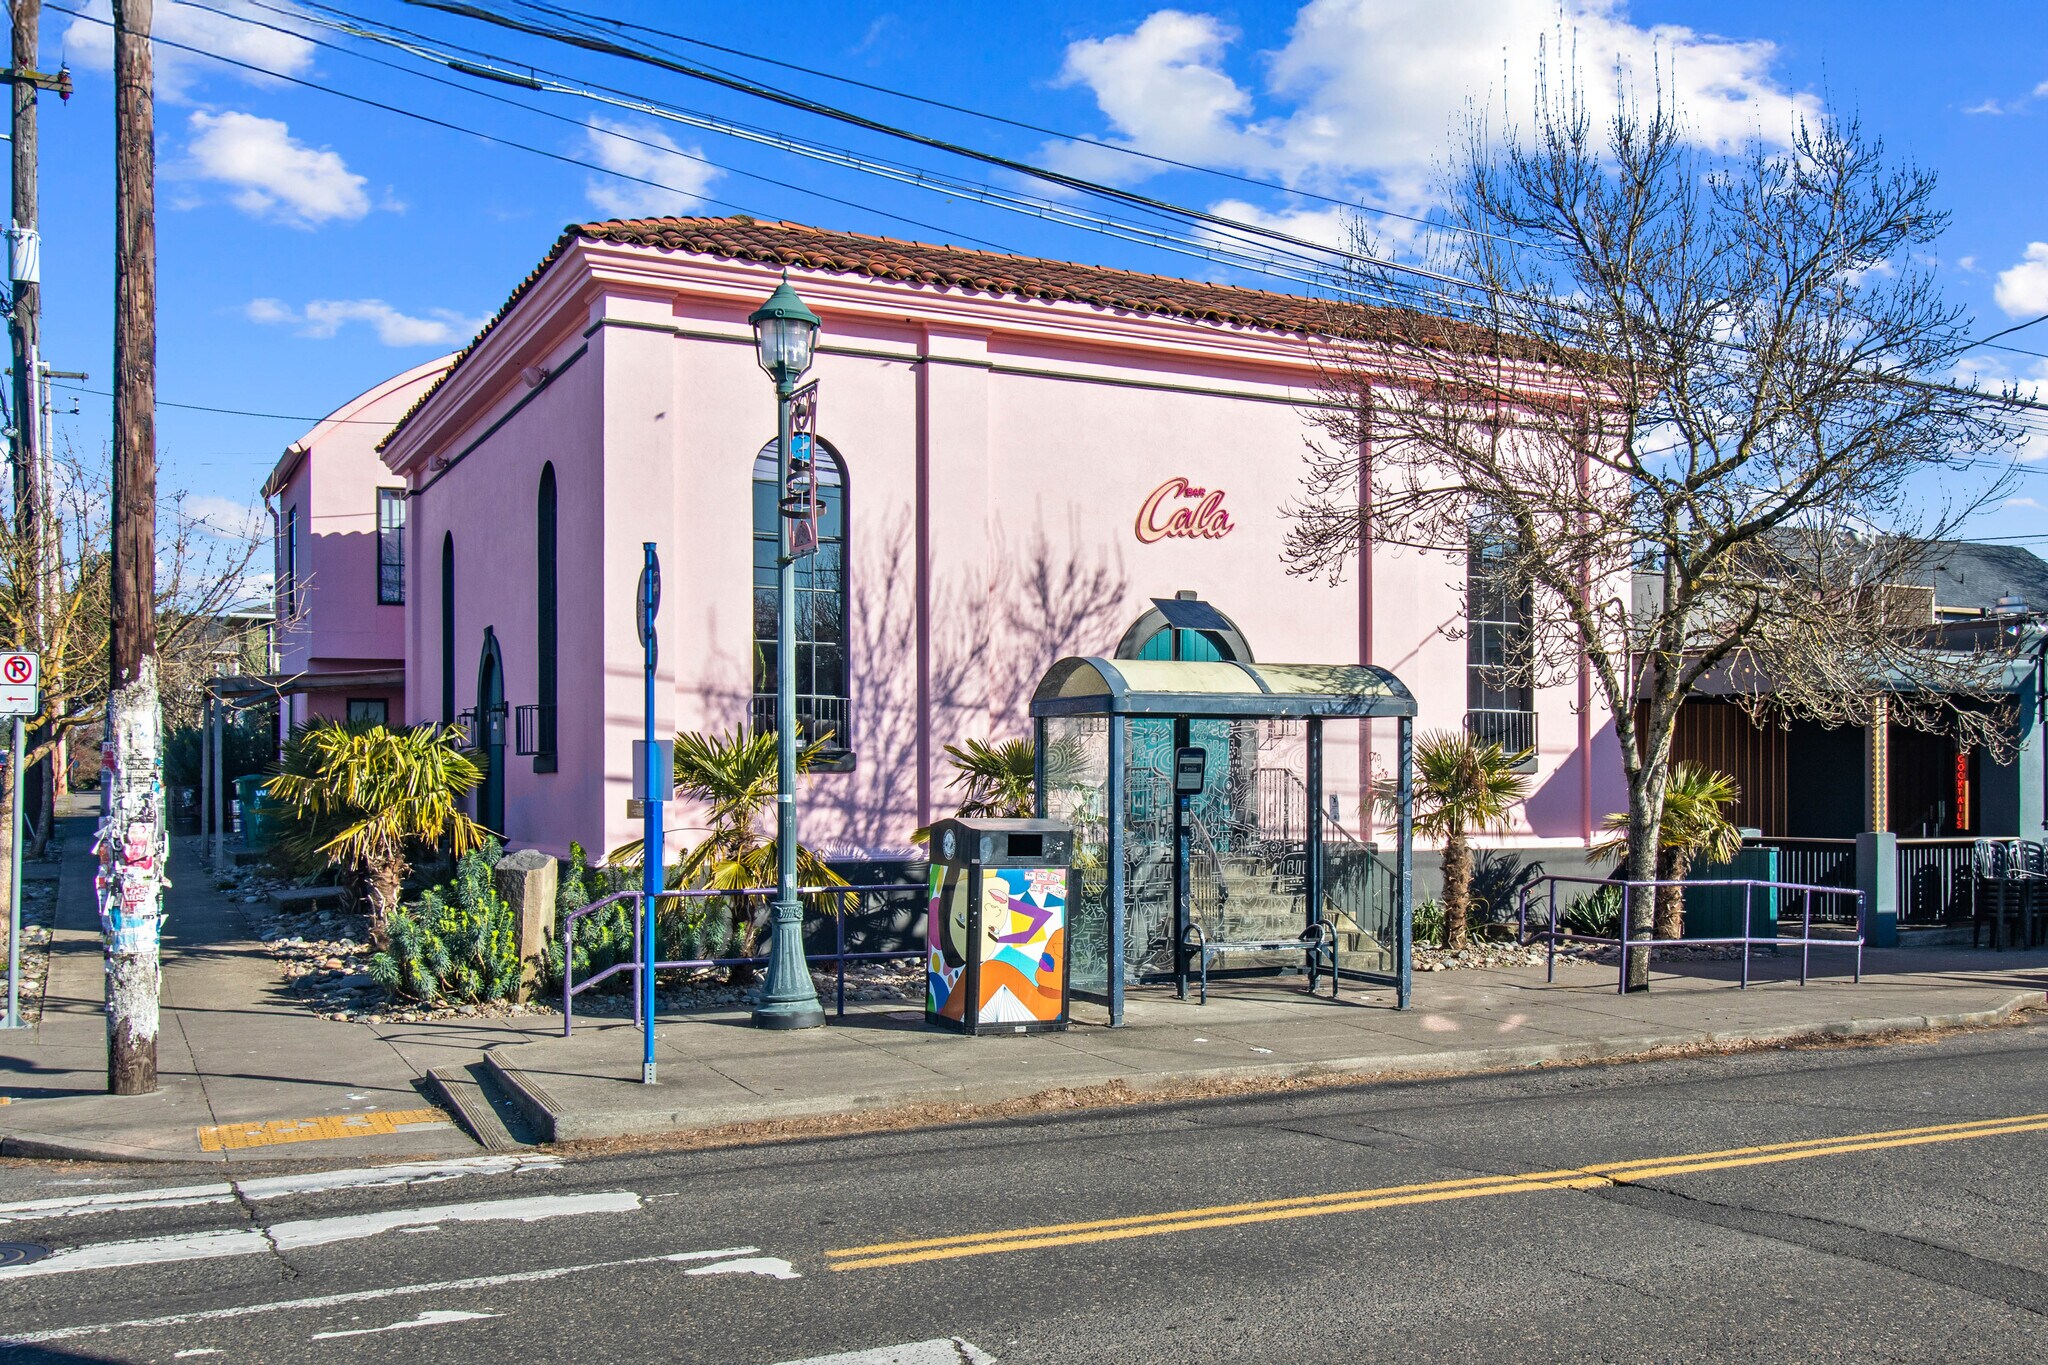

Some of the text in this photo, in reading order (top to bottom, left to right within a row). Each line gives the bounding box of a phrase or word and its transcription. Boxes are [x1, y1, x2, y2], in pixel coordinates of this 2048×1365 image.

[1135, 477, 1235, 544] Cala
[1185, 488, 1206, 498] BAR
[1957, 753, 1965, 829] COCKTAILS
